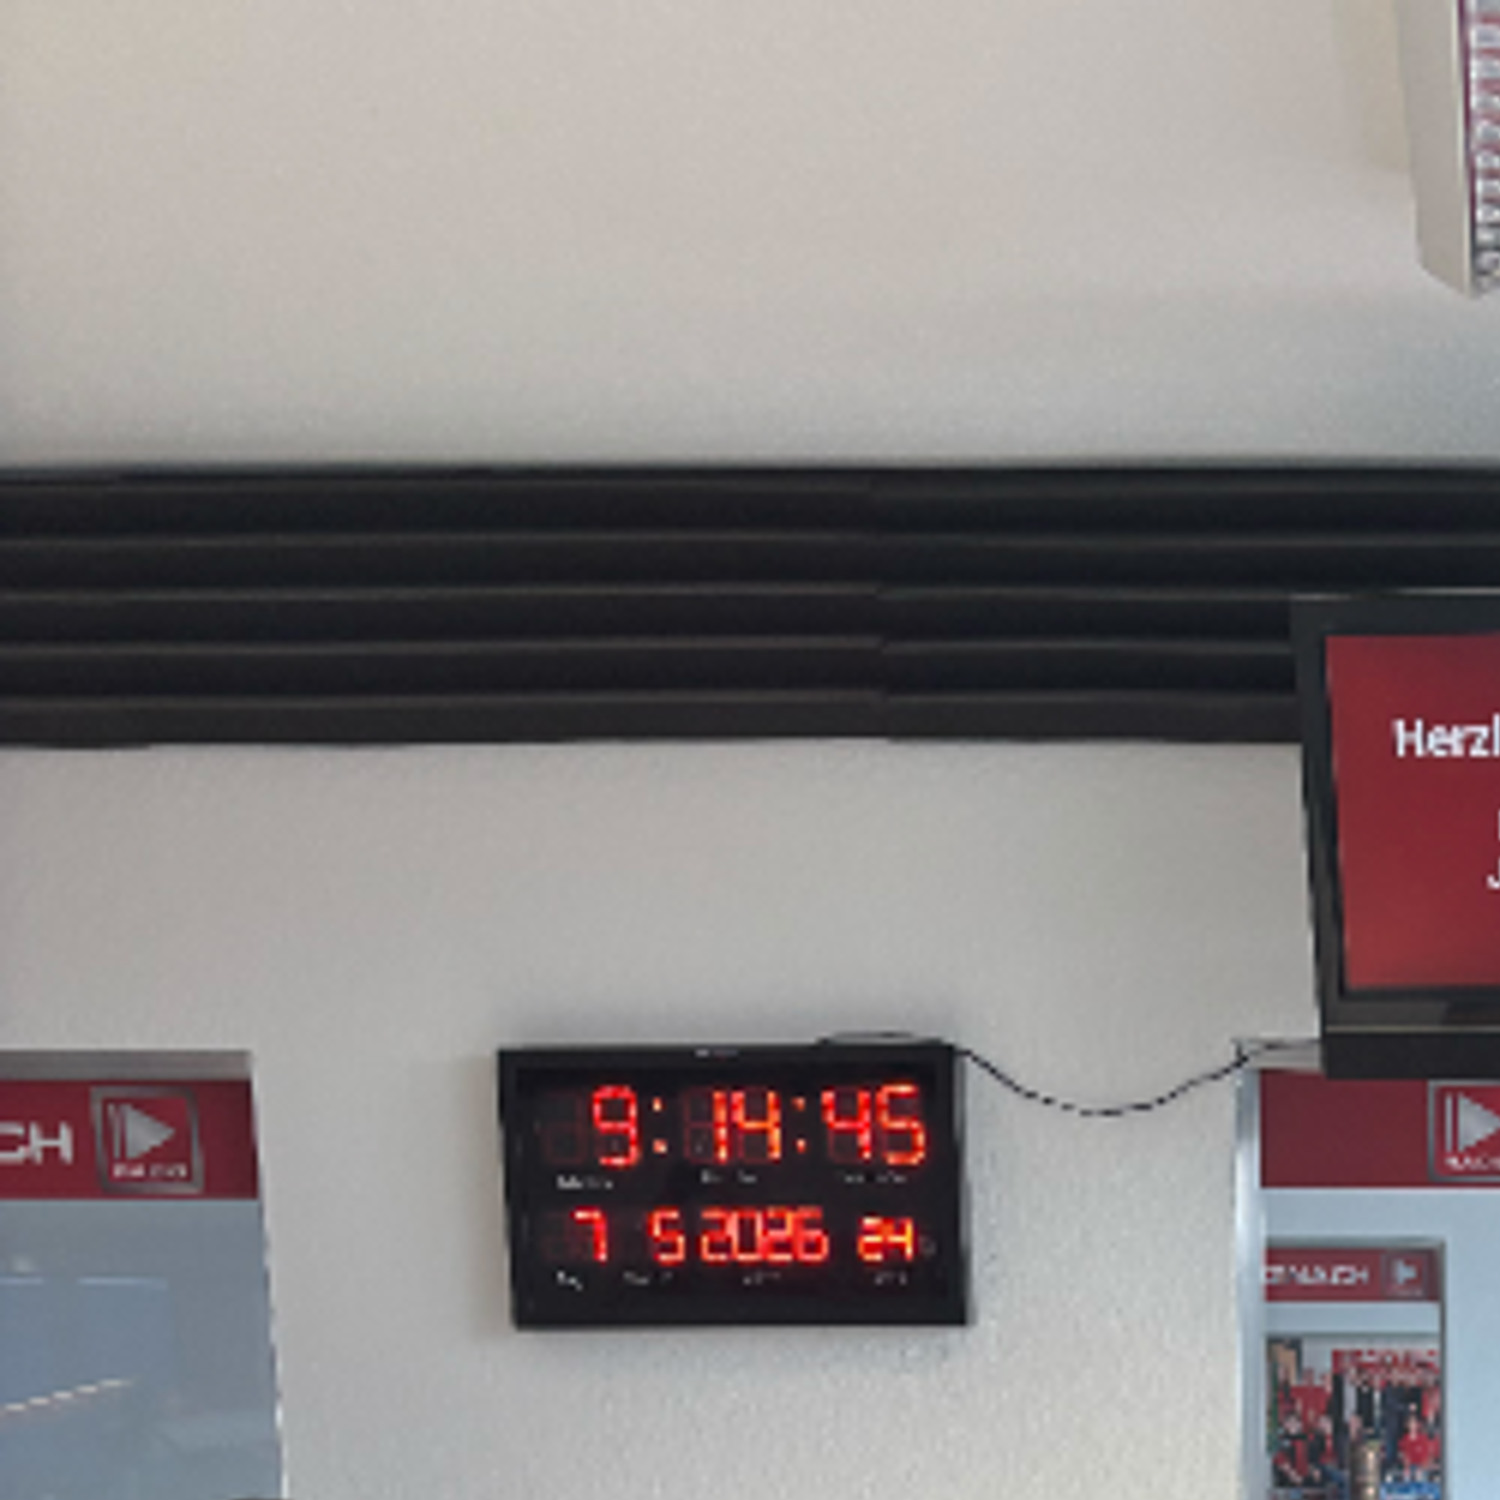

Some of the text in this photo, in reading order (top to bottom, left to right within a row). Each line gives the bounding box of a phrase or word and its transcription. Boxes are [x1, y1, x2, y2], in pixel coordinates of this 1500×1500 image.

[574, 1207, 609, 1264] 7
[647, 1207, 686, 1265] 5
[699, 1206, 829, 1265] 2026
